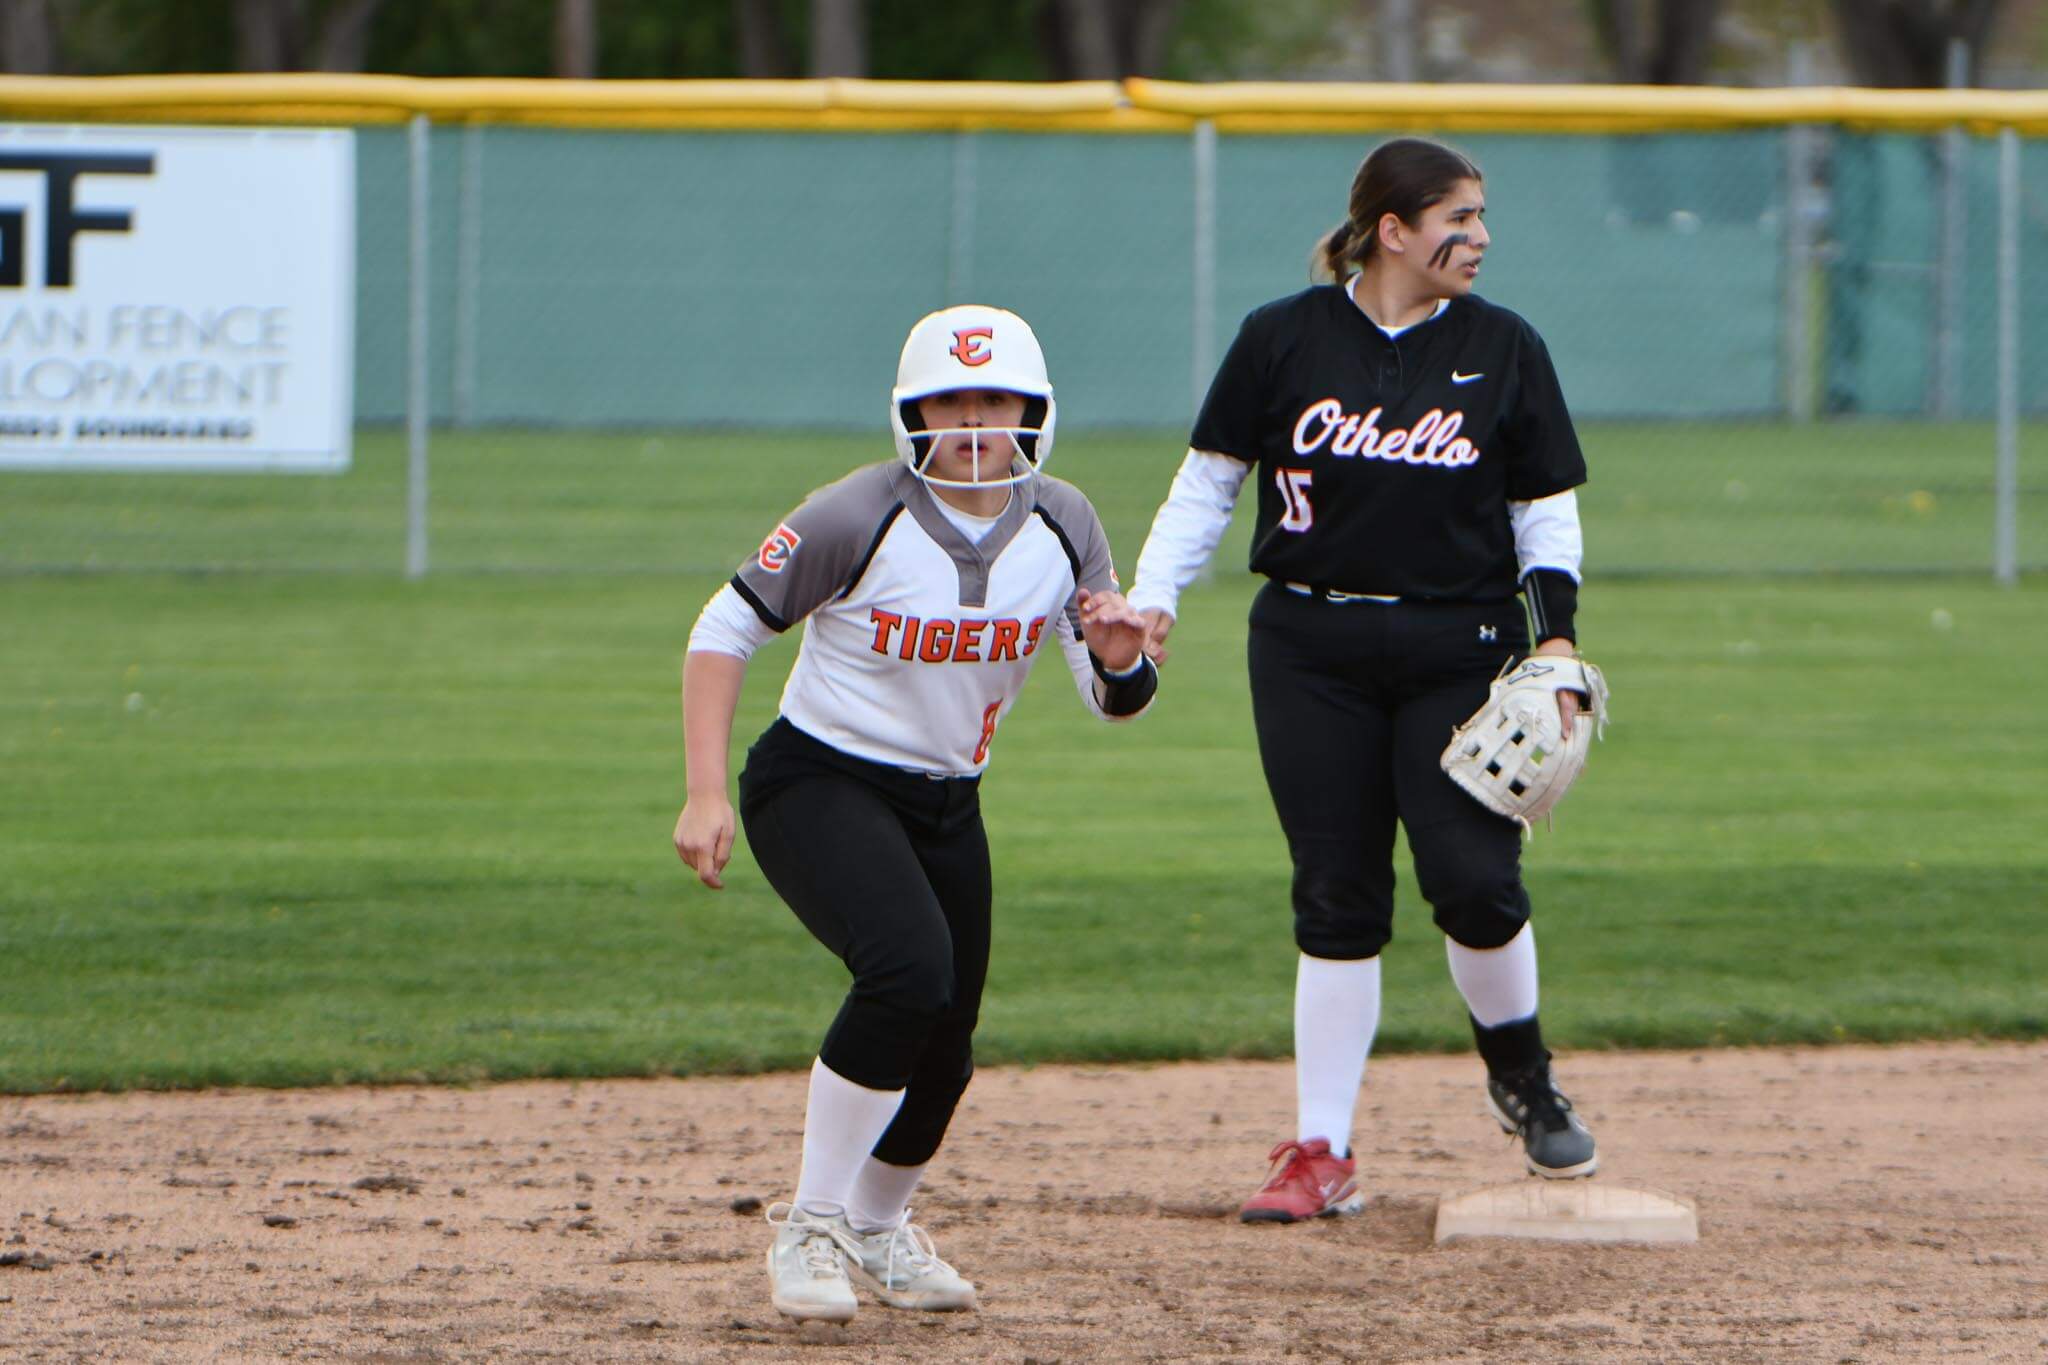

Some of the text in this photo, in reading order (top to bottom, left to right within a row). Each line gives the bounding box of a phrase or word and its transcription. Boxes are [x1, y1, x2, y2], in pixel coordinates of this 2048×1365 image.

[108, 304, 289, 350] FENCE
[949, 326, 993, 363] E
[1292, 397, 1480, 469] Othello
[1275, 467, 1313, 533] 15
[870, 607, 1048, 663] TIGERS
